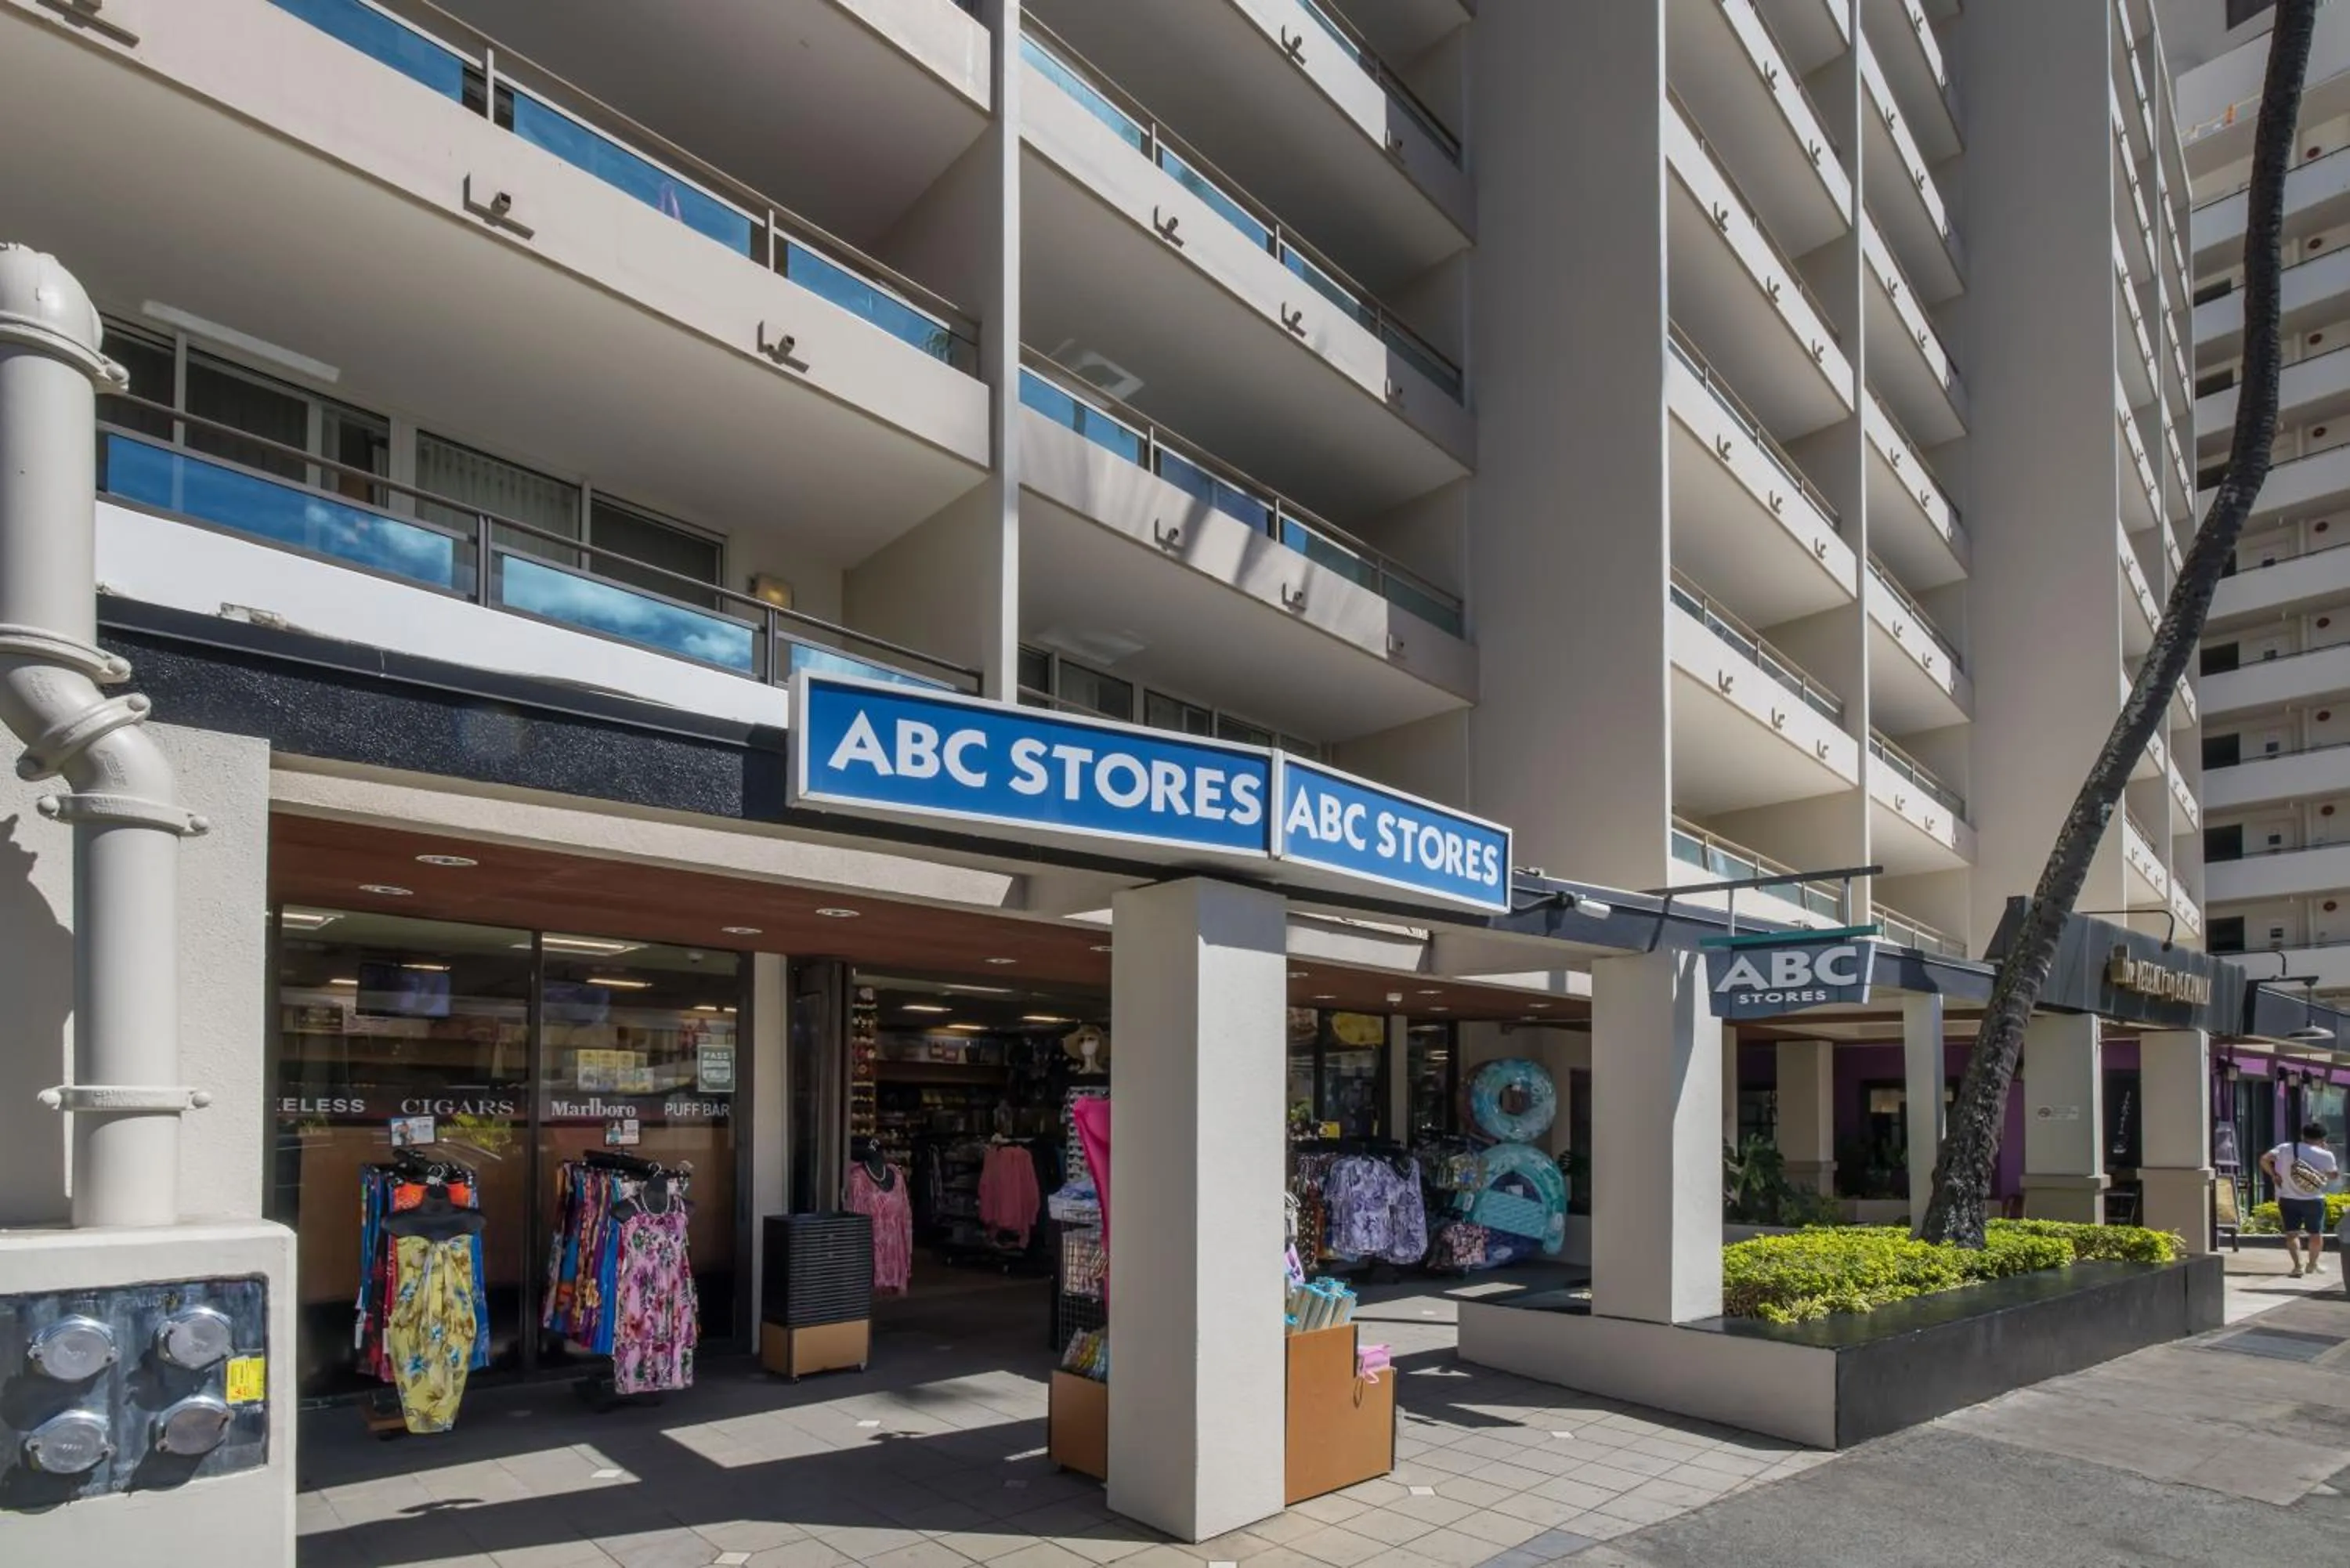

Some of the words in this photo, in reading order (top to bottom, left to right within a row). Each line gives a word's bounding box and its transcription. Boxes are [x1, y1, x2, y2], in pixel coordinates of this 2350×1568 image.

[828, 710, 987, 787] ABC
[1009, 739, 1262, 825] STORES
[1286, 786, 1366, 850] ABC
[1377, 812, 1499, 887] STORES
[1715, 945, 1856, 992] ABC
[1738, 990, 1827, 1005] STORES
[401, 1098, 515, 1116] CIGARS
[551, 1097, 637, 1118] Marlboro
[664, 1102, 700, 1116] PUFF
[703, 1104, 730, 1116] BAR
